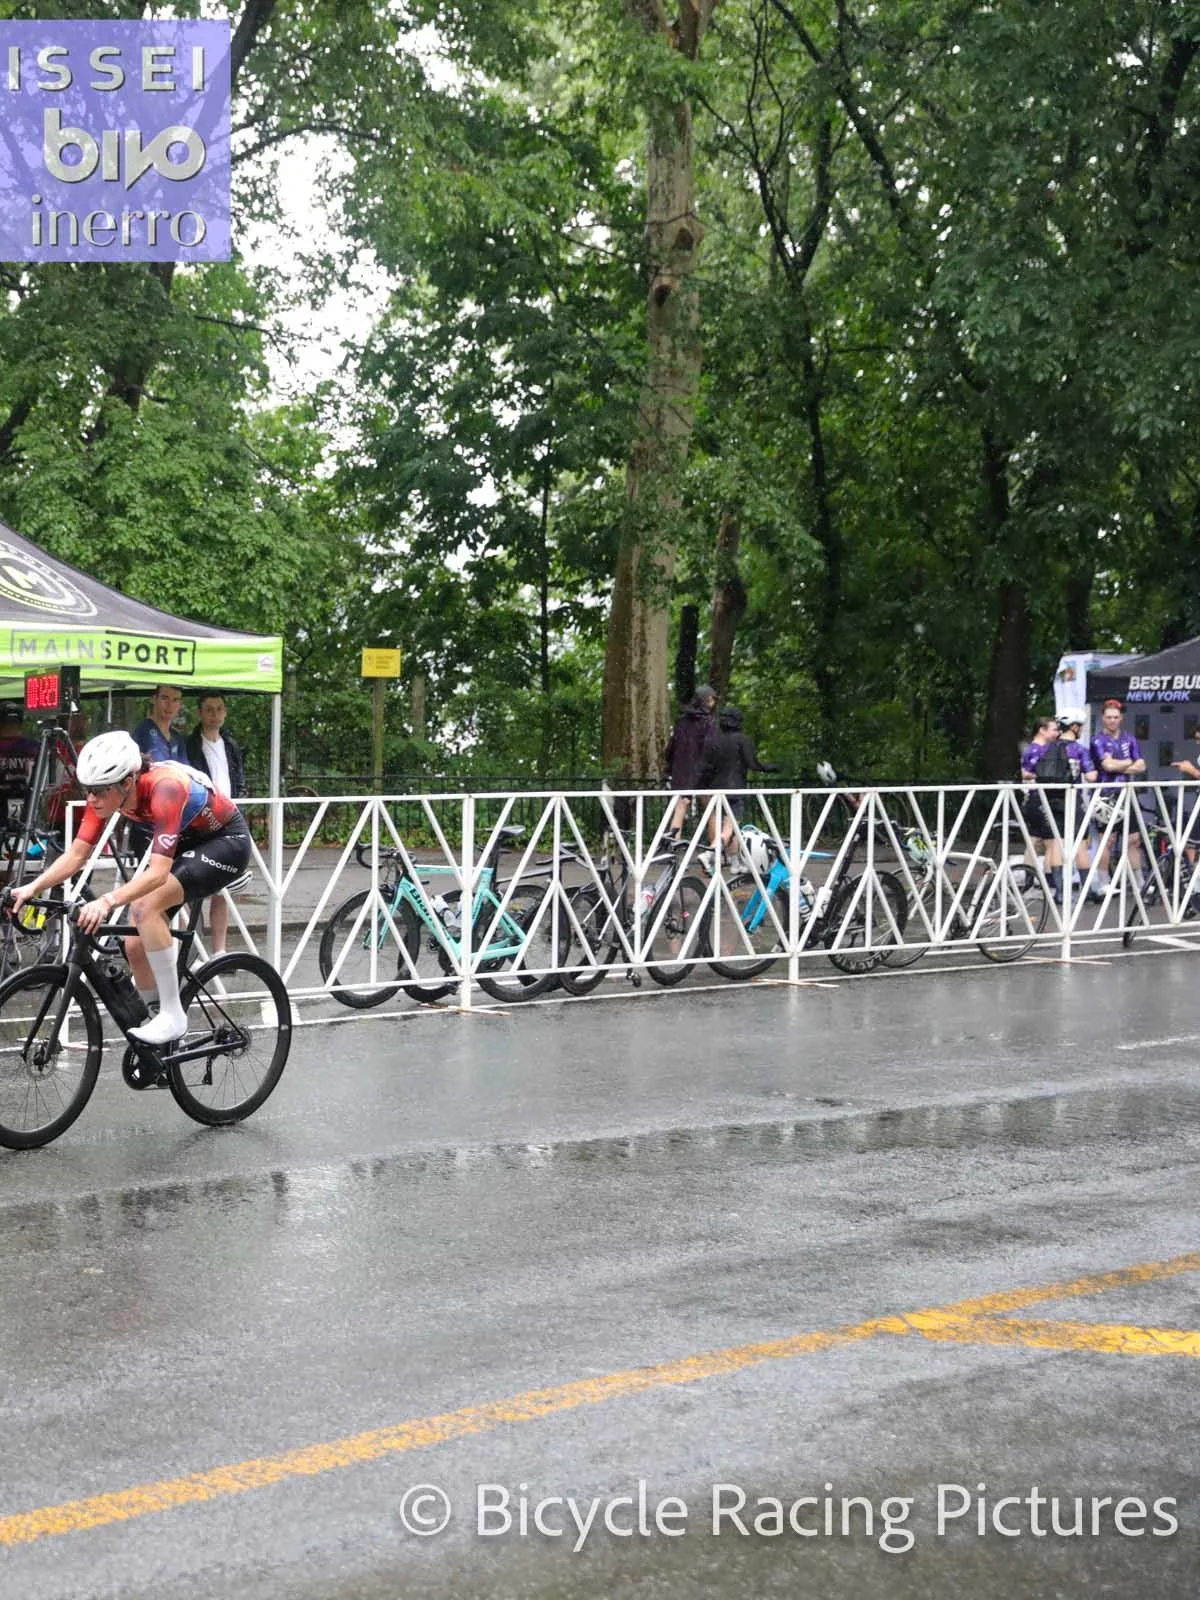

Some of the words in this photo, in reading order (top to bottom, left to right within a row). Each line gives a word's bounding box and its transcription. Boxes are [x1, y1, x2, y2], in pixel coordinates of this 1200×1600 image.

[18, 638, 188, 666] MAINSPORT
[1128, 675, 1172, 690] BEST
[1126, 690, 1155, 702] NEW
[1157, 690, 1191, 702] YORK
[201, 854, 238, 874] boostie
